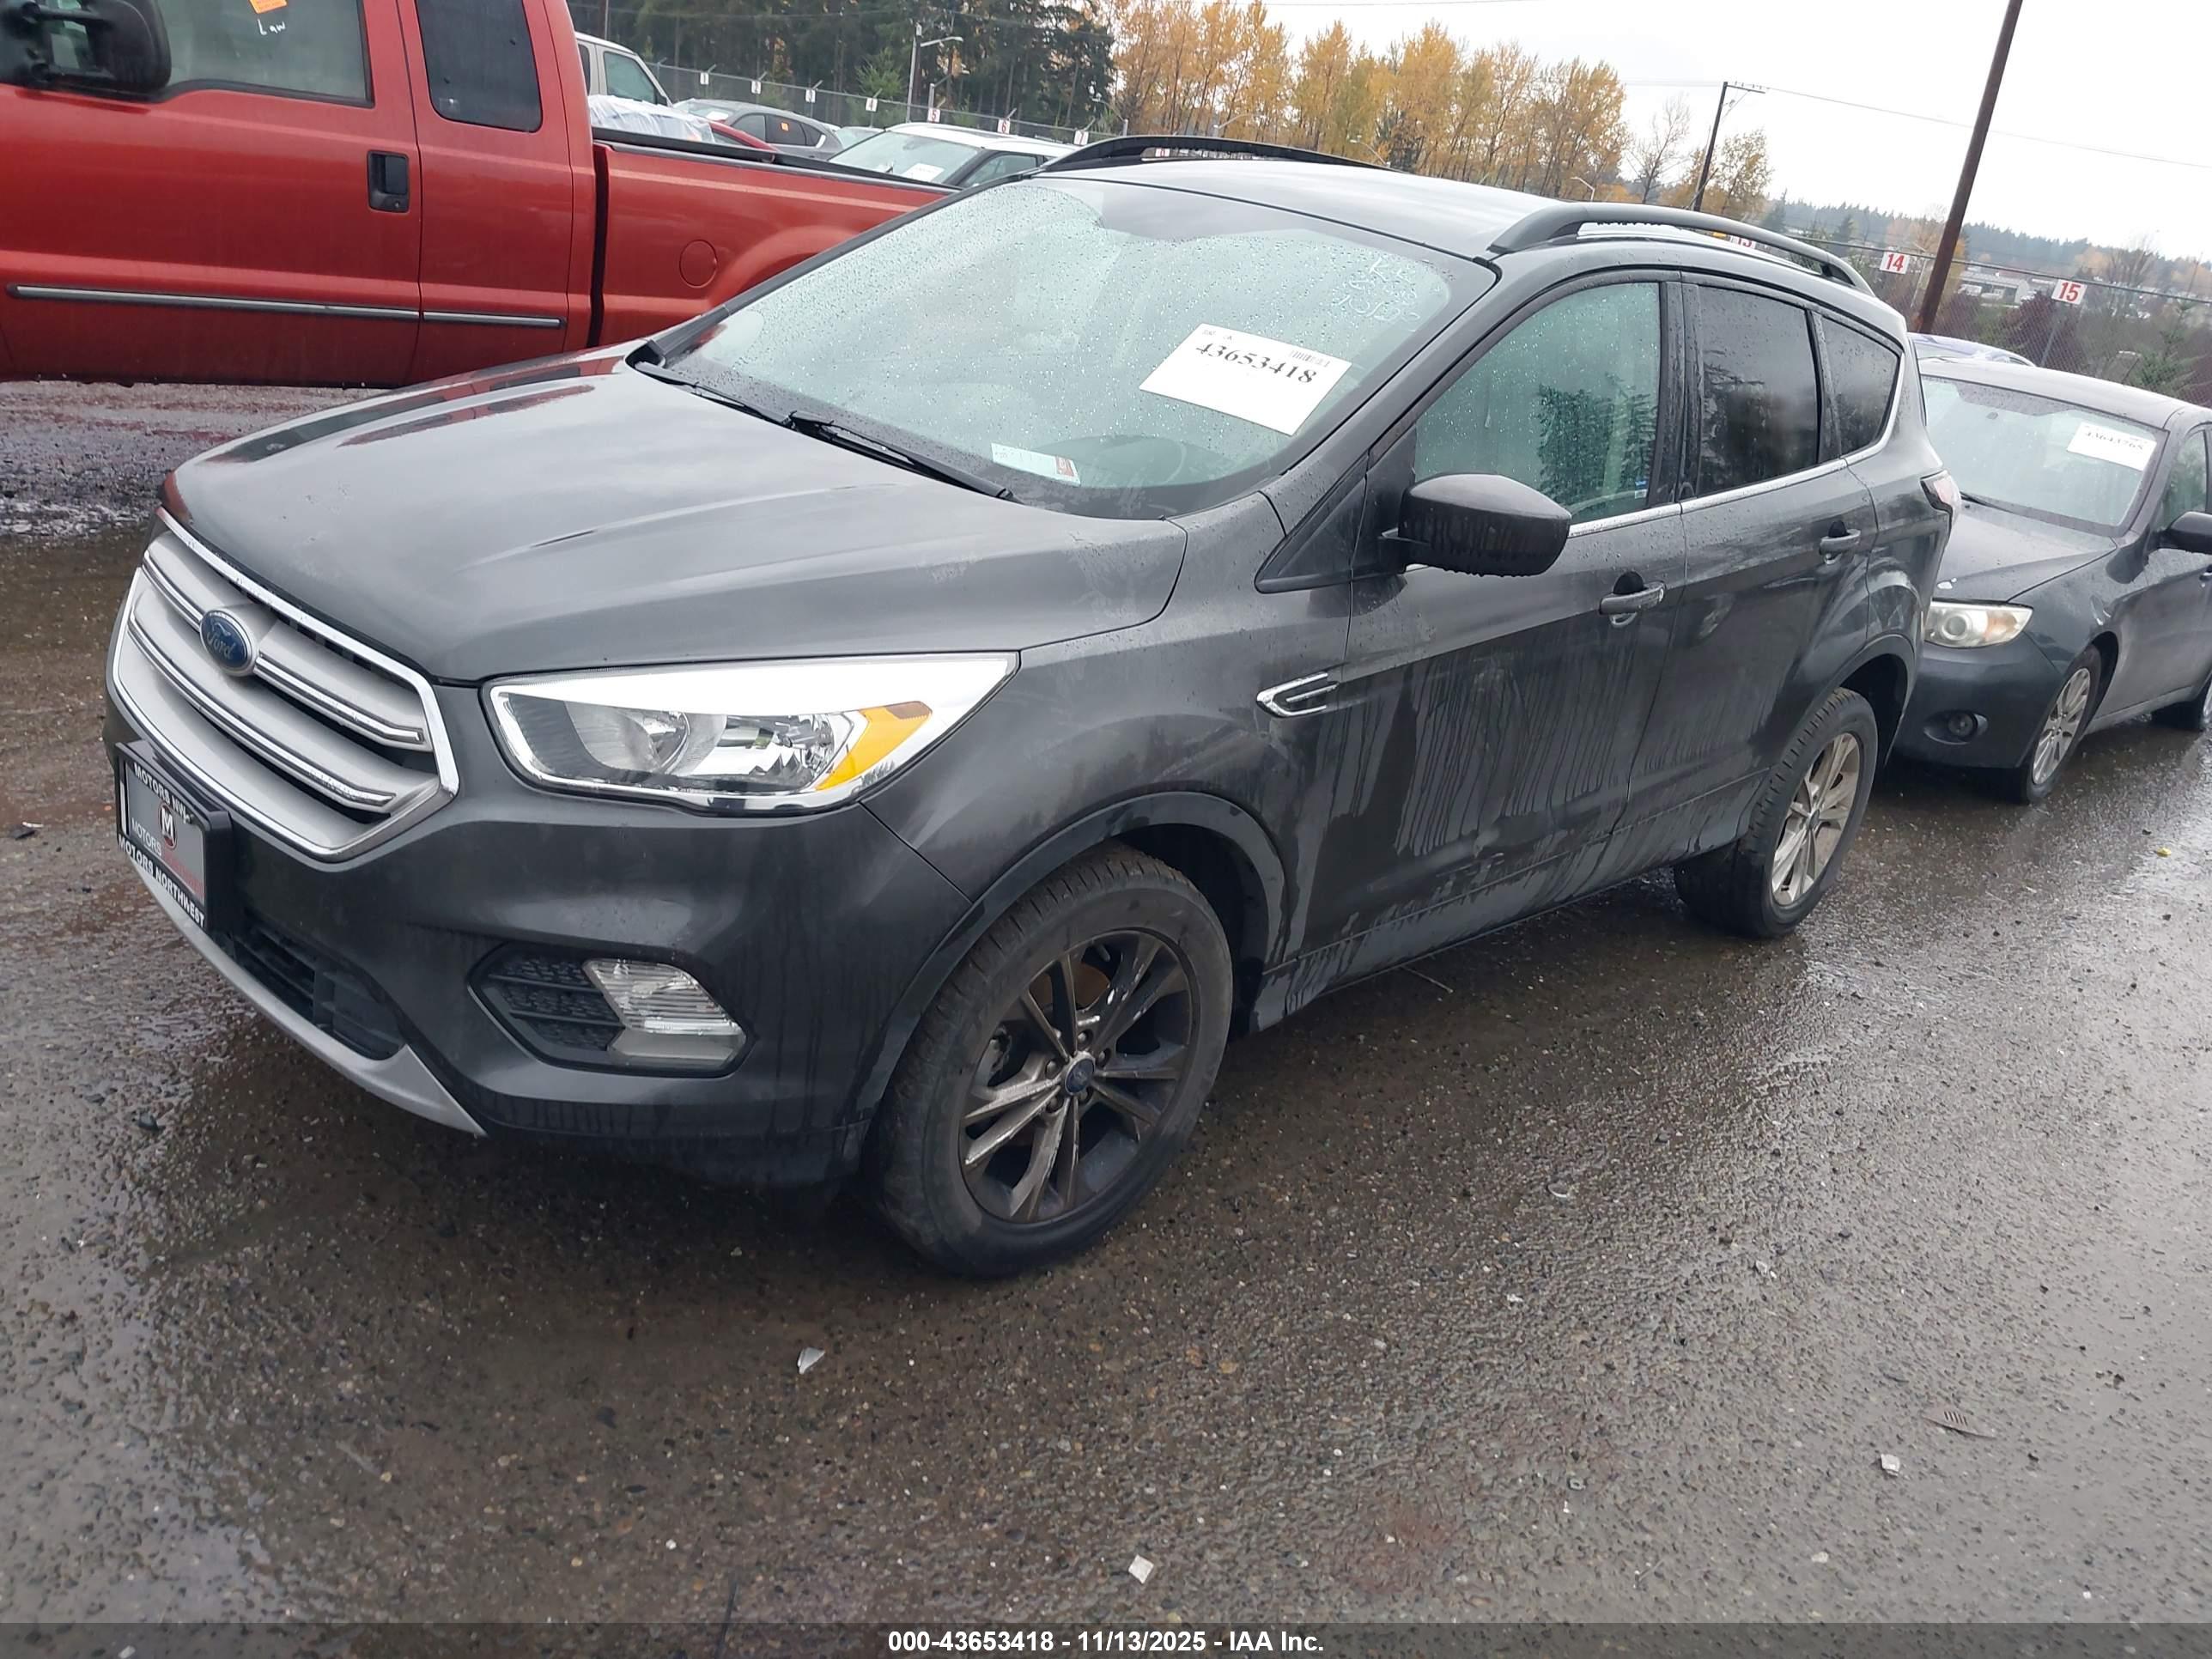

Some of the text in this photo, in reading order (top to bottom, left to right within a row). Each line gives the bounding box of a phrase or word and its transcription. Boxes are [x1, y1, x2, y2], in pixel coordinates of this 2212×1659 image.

[931, 109, 938, 121] 5
[1000, 119, 1008, 132] 6
[1886, 253, 1905, 271] 14
[2058, 282, 2081, 302] 15
[1194, 342, 1318, 384] 43653418
[133, 762, 171, 805] MOTORS
[131, 816, 163, 857] MOTORS
[159, 805, 176, 842] M
[118, 834, 155, 876] MOTORS
[155, 866, 206, 928] NORTHWEST
